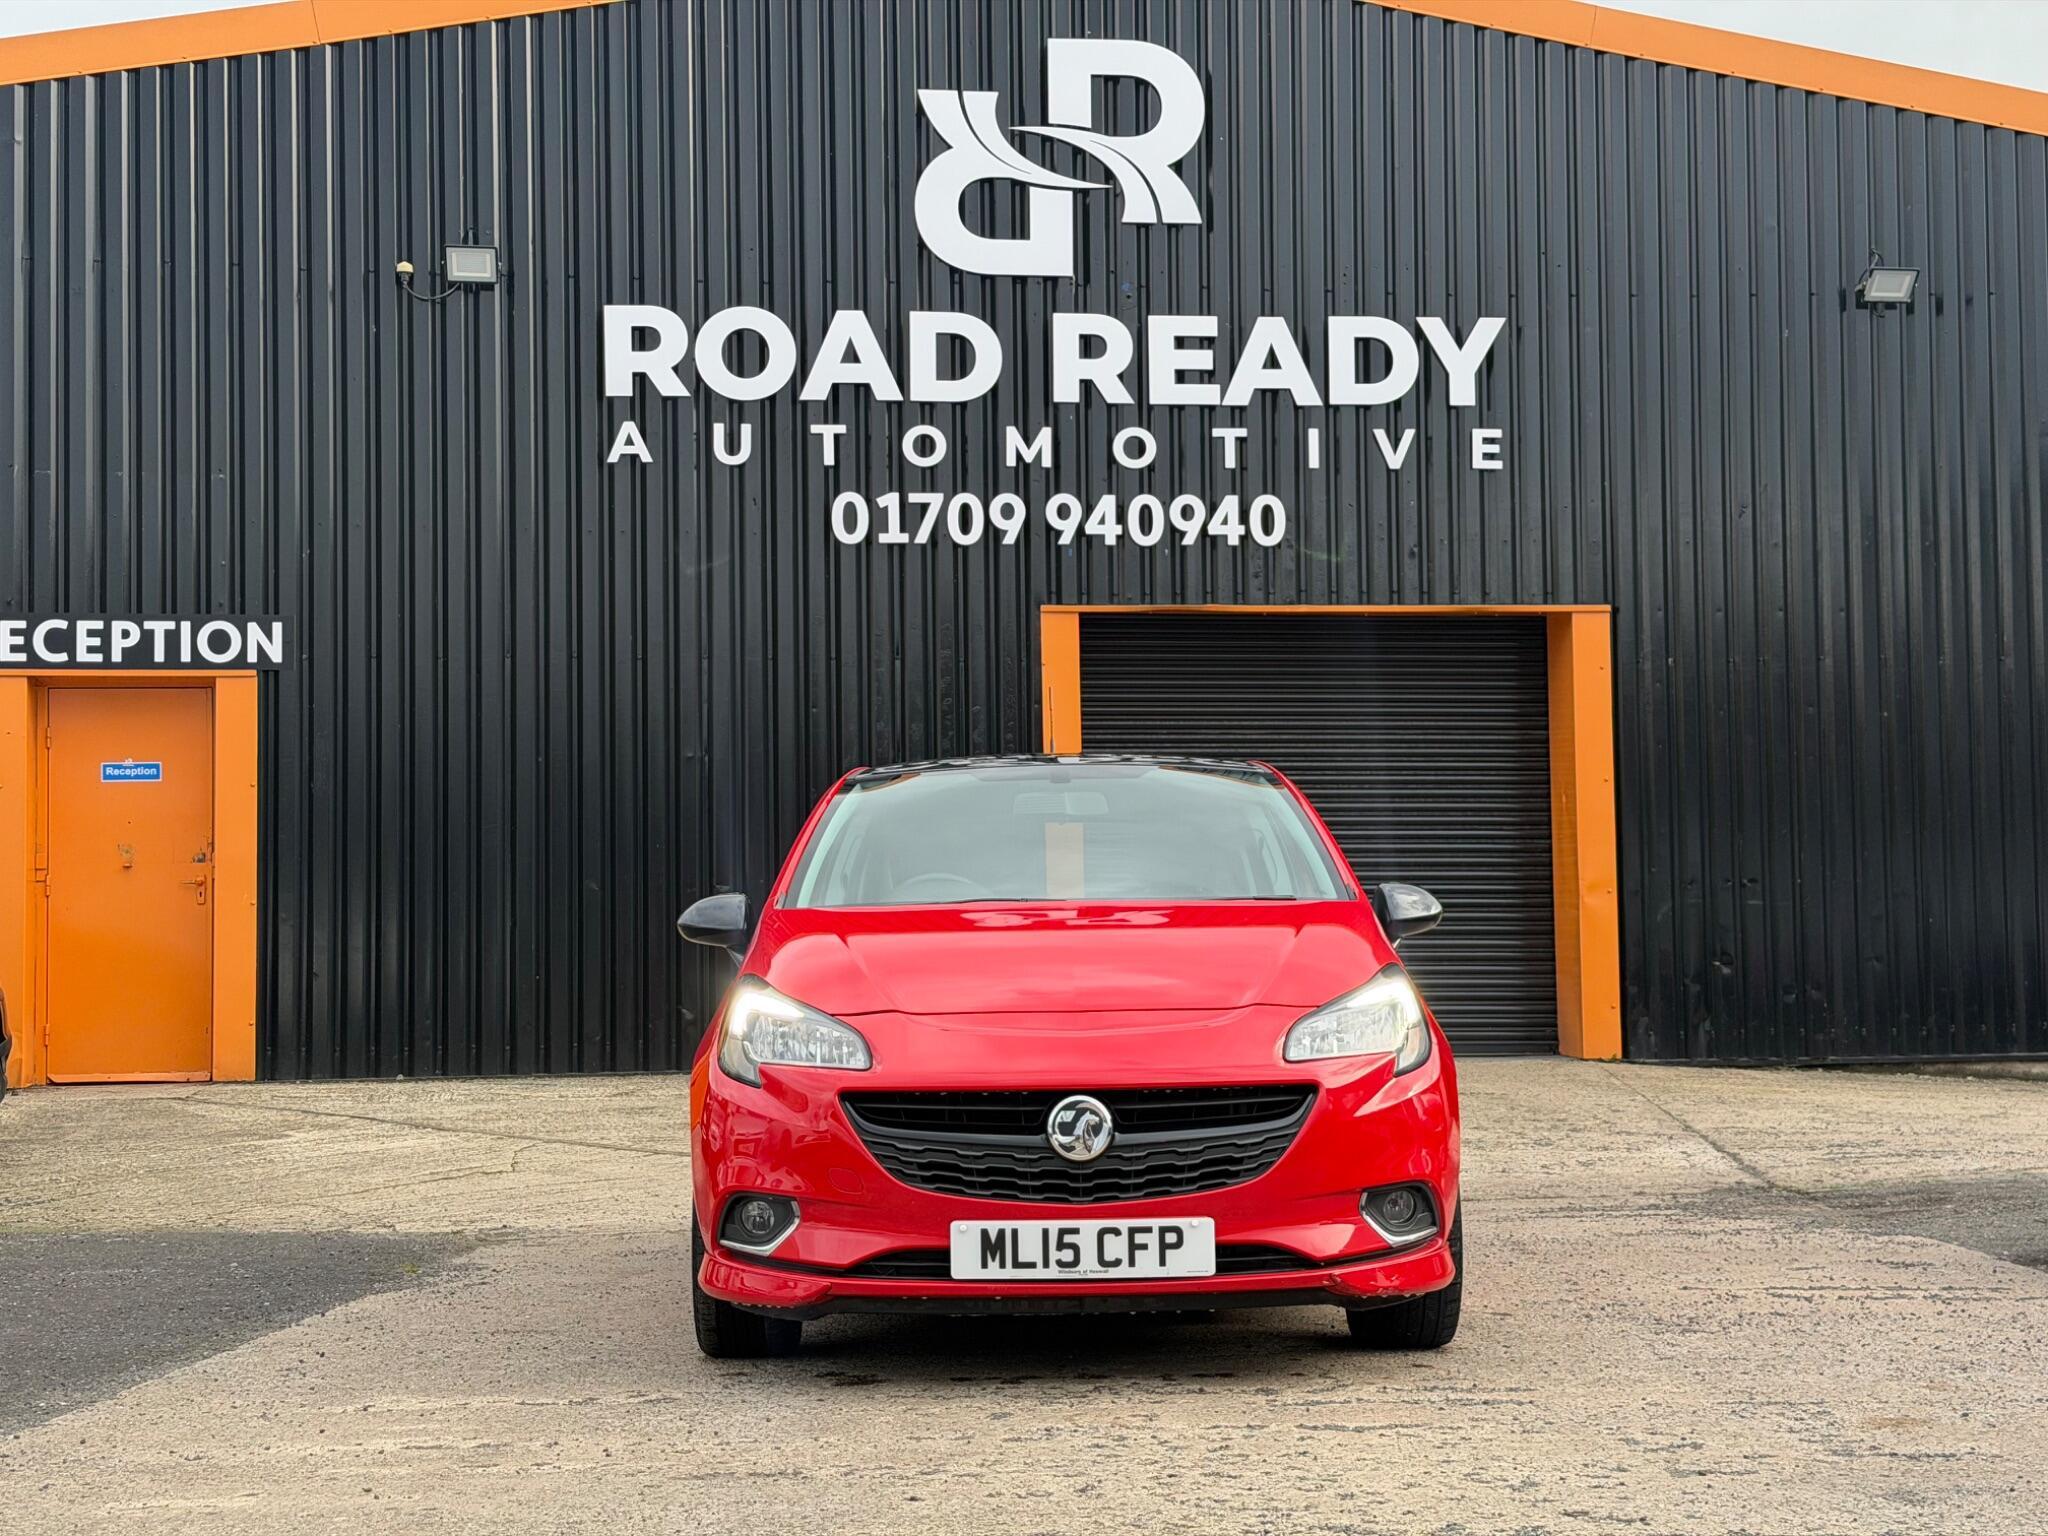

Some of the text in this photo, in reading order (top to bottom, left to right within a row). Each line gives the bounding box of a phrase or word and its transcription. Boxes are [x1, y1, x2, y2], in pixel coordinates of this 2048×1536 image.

[603, 304, 1507, 407] ROAD READY
[606, 420, 1505, 470] AUTOMOTIVE
[831, 491, 1287, 547] 01709 940940
[0, 618, 283, 665] ECEPTION
[105, 766, 158, 777] Reception
[980, 1225, 1185, 1270] ML15 CFP
